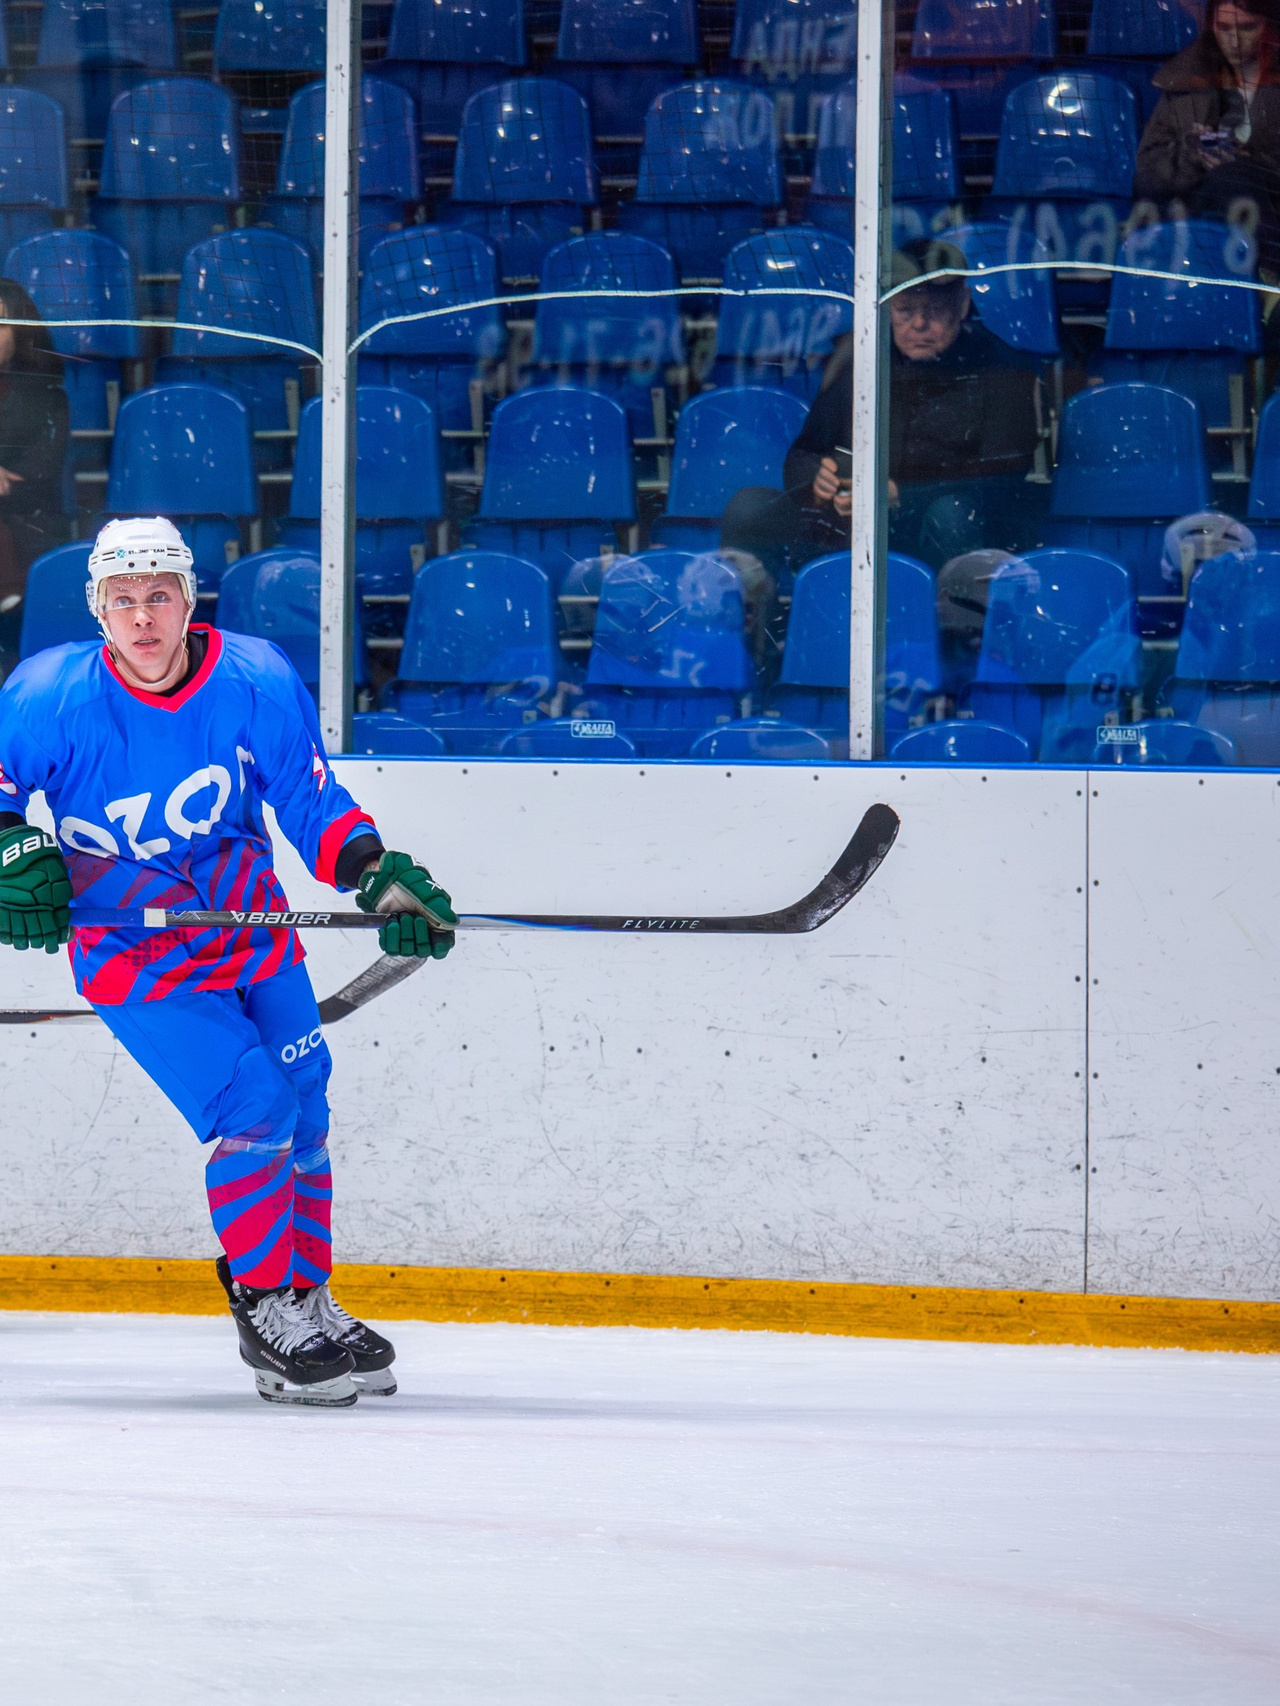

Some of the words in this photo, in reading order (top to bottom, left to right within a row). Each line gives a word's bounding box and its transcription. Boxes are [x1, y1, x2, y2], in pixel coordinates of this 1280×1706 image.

[2, 834, 62, 867] BAU
[247, 911, 331, 925] BAUER
[622, 919, 700, 929] FLYLITE
[281, 1024, 323, 1064] OZO
[260, 1350, 287, 1371] BAUER
